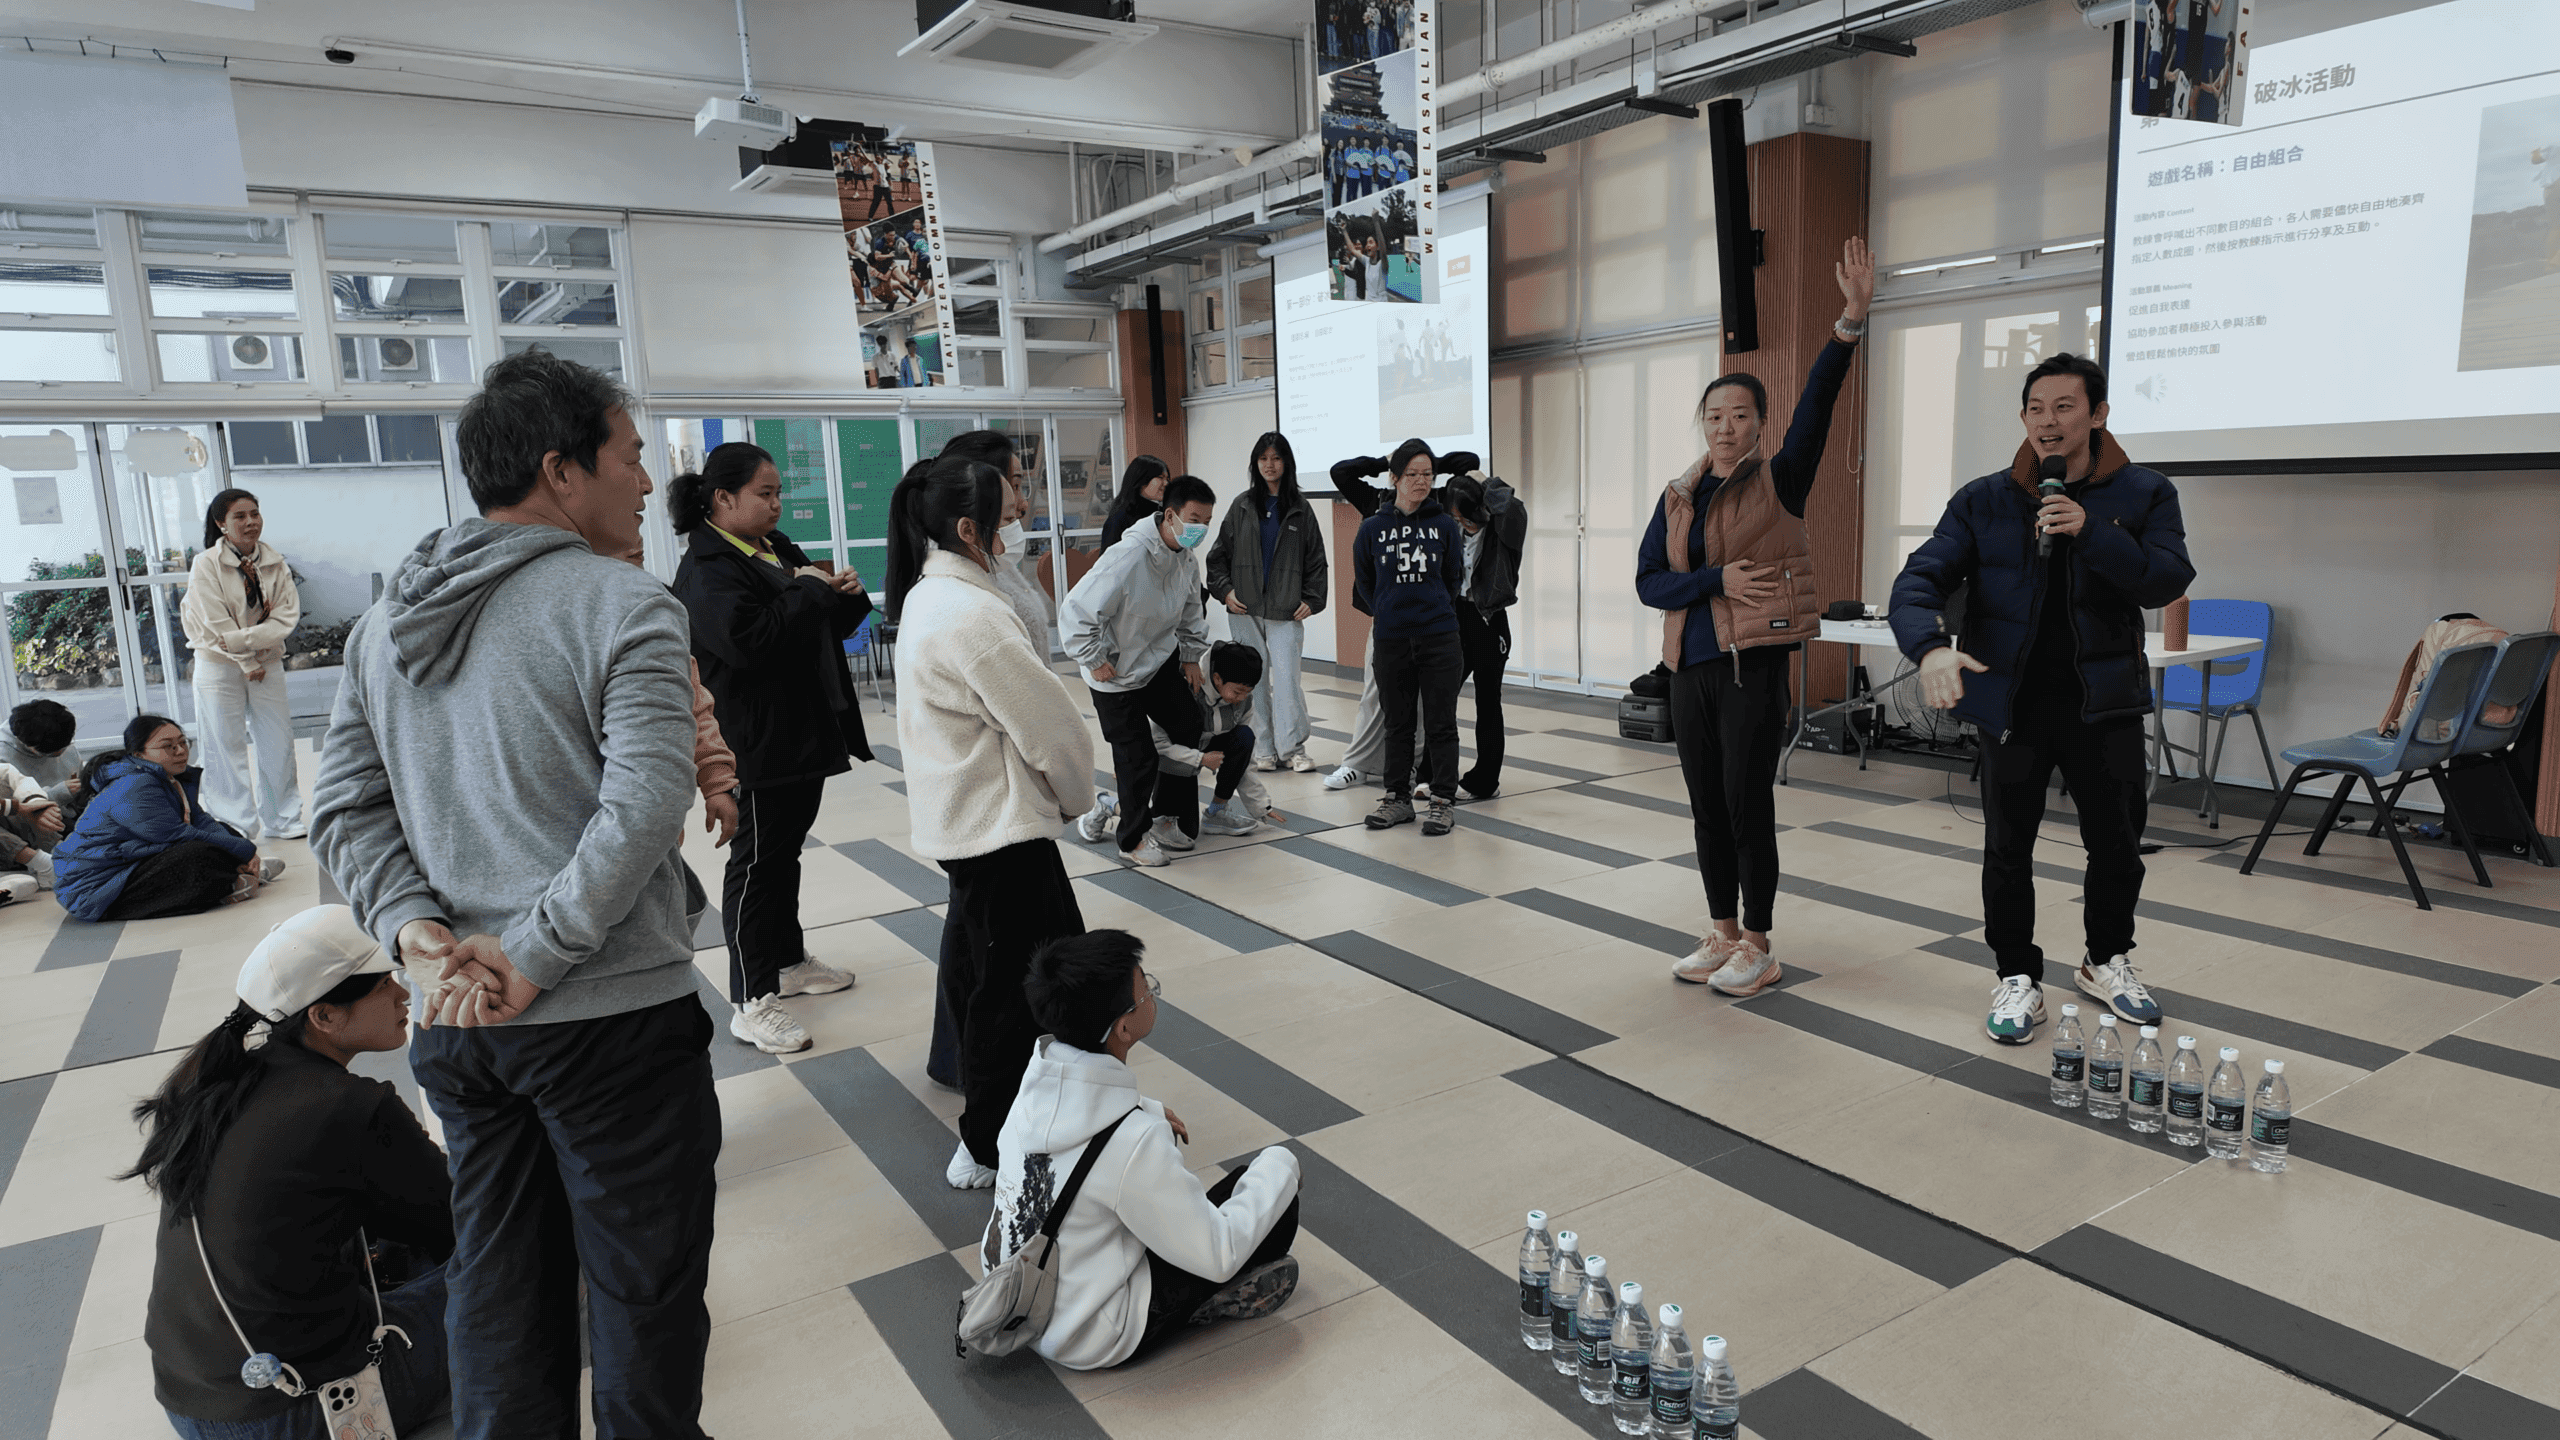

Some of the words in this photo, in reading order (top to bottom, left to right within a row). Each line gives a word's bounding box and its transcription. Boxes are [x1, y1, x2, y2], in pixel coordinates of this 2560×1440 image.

[1420, 12, 1431, 151] LASALLIAN
[2254, 62, 2357, 105] 破冰活動
[2148, 144, 2304, 188] 遊戲名稱：自由組合
[1423, 168, 1432, 210] ARE
[921, 160, 943, 262] COMMUNITY
[2166, 207, 2195, 218] Content
[1424, 228, 1434, 254] WE
[937, 272, 948, 311] ZEAL
[2162, 282, 2193, 292] Meaning
[2128, 299, 2191, 316] 促進自我表達
[942, 321, 954, 368] FAITH
[1378, 525, 1439, 543] JAPAN
[1396, 542, 1428, 573] 54
